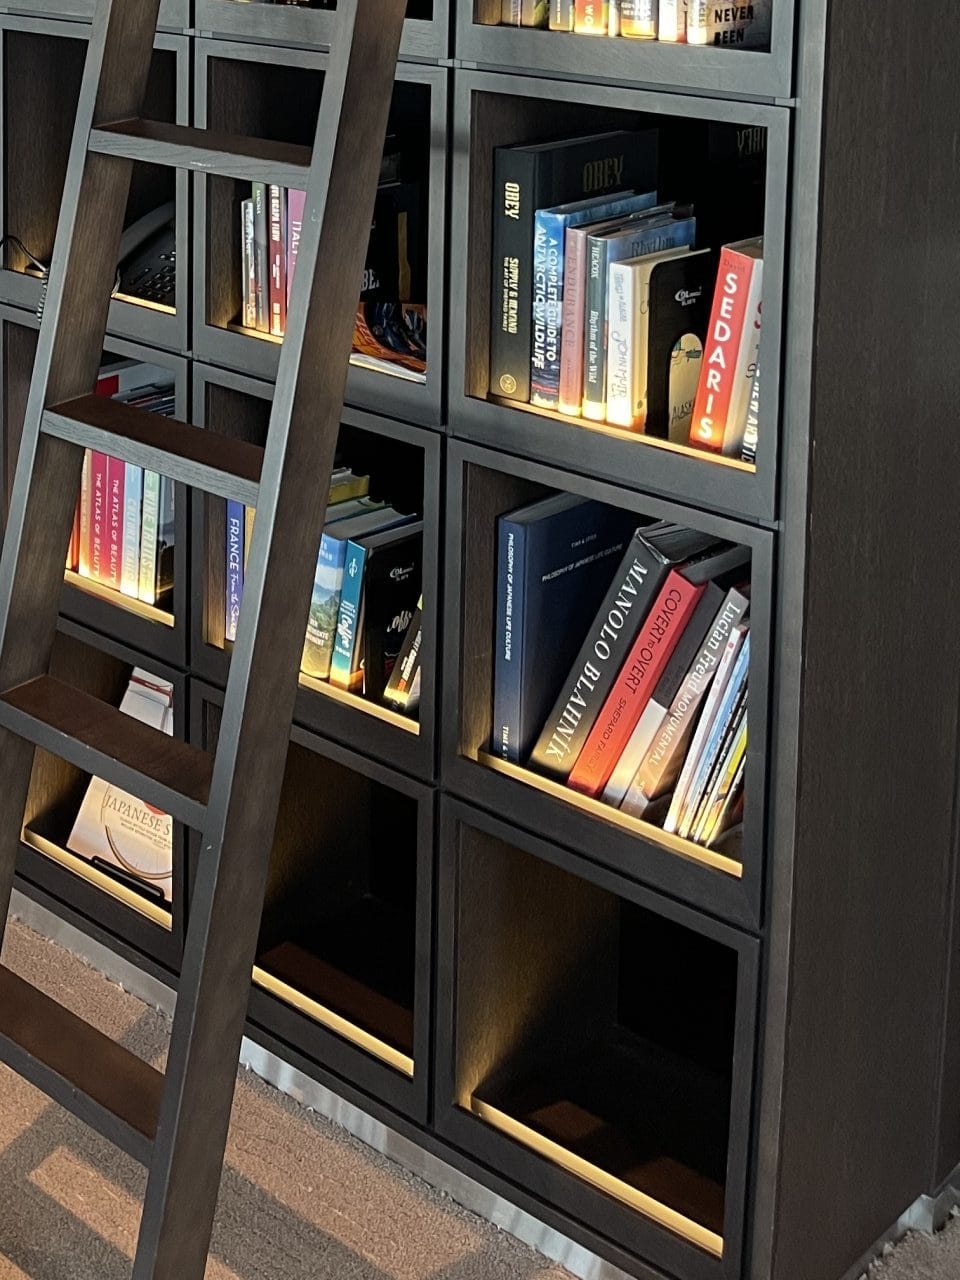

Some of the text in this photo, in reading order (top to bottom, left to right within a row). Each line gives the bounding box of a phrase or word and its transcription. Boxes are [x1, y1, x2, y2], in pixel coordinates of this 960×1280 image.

[714, 4, 754, 23] NEVER
[713, 28, 744, 46] BEEN
[583, 155, 624, 193] OBEY
[504, 183, 520, 219] OBEY
[508, 257, 519, 290] SUPPLY
[532, 225, 547, 369] ANTARCTIC WILDLIFE
[547, 238, 559, 361] A COMPLETE GUIDE TO
[566, 257, 576, 347] ENDURANCE
[589, 311, 599, 340] Rhythm
[589, 350, 597, 363] the
[611, 331, 628, 367] JOHN
[697, 273, 738, 440] SEDARIS
[588, 365, 597, 384] Wild
[94, 489, 102, 521] ATLAS
[111, 495, 119, 527] ATLAS
[145, 490, 156, 522] WINE
[94, 524, 100, 535] OF
[111, 530, 118, 541] OF
[230, 518, 240, 571] FRANCE
[92, 538, 100, 578] BEAUTY
[109, 544, 118, 584] BEAUTY
[507, 573, 513, 583] OF
[649, 588, 682, 643] COVERT
[544, 557, 649, 765] MANOLO BLAHNÍK
[623, 646, 654, 695] OVERT
[648, 602, 741, 764] Lucian Freud MONUMENTAL
[602, 698, 628, 741] SHEPARD
[103, 793, 164, 830] JAPANESE
